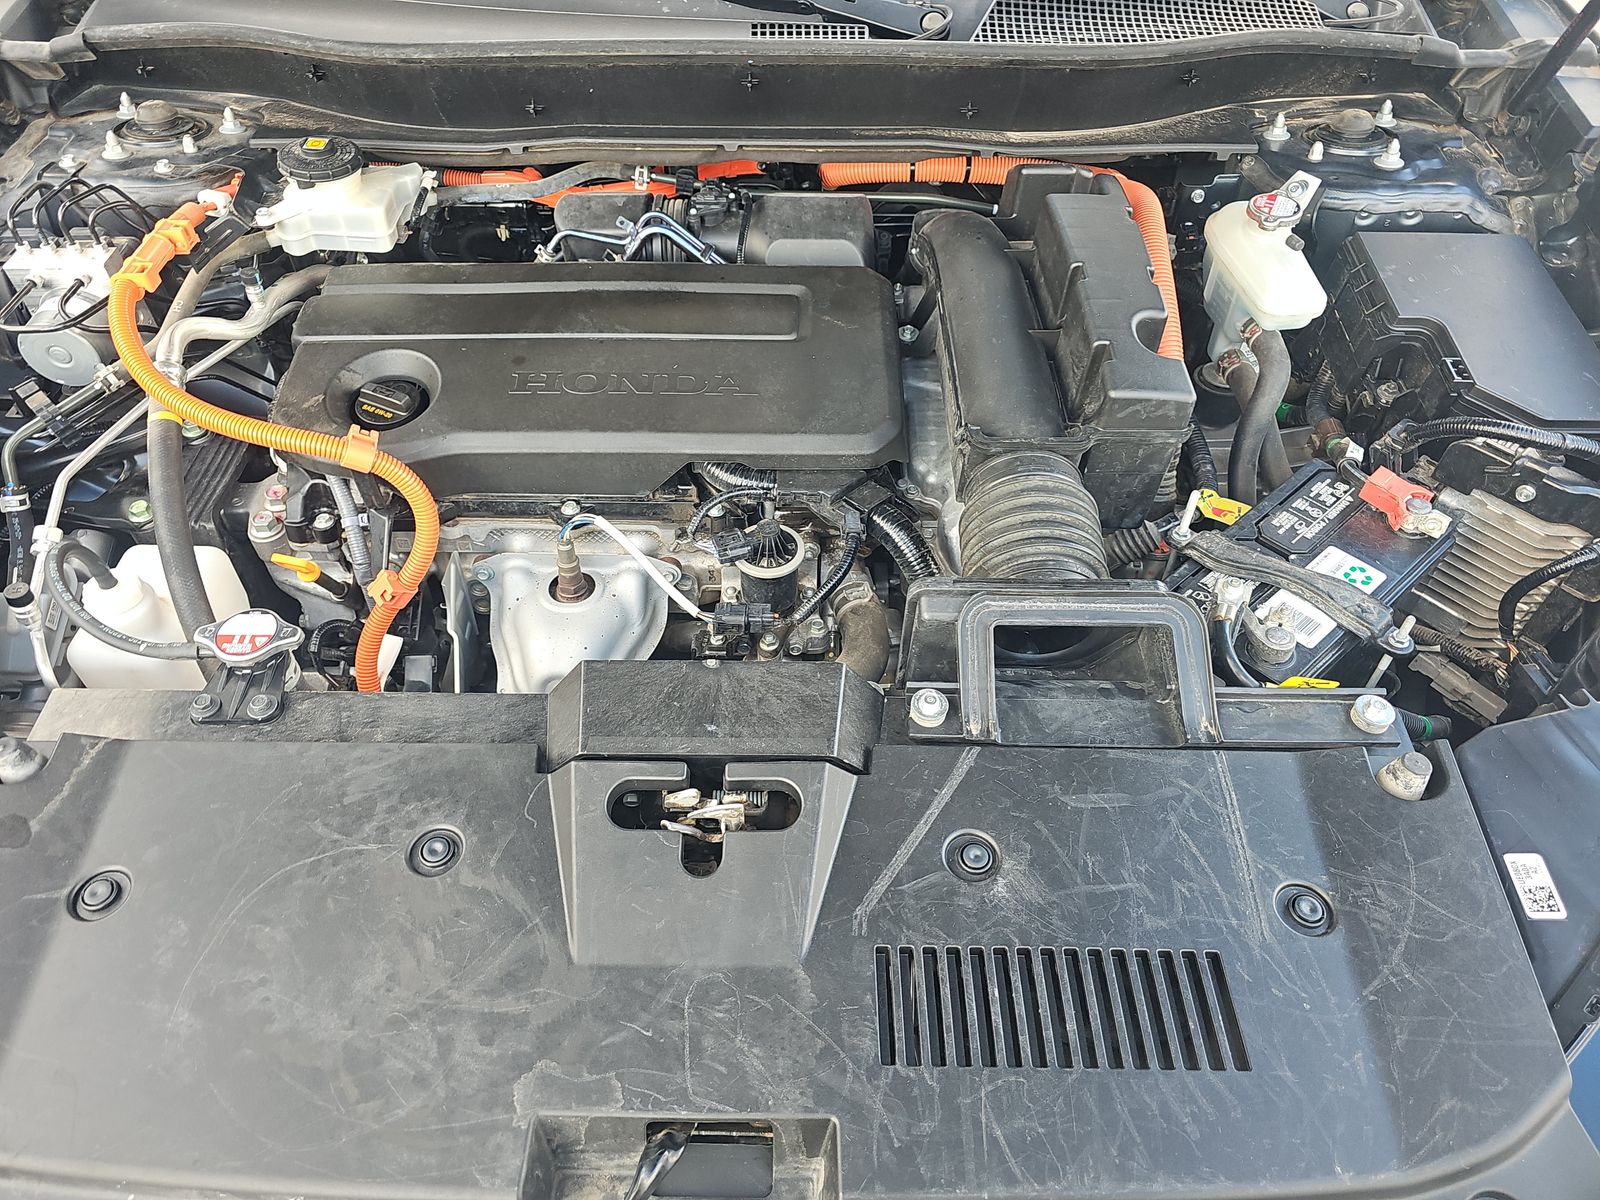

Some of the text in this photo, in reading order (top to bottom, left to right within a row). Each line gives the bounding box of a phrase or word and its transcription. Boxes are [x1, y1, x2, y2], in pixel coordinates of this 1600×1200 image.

[508, 371, 760, 396] HONDA
[1326, 500, 1351, 520] DANGER
[1303, 521, 1327, 540] POISON
